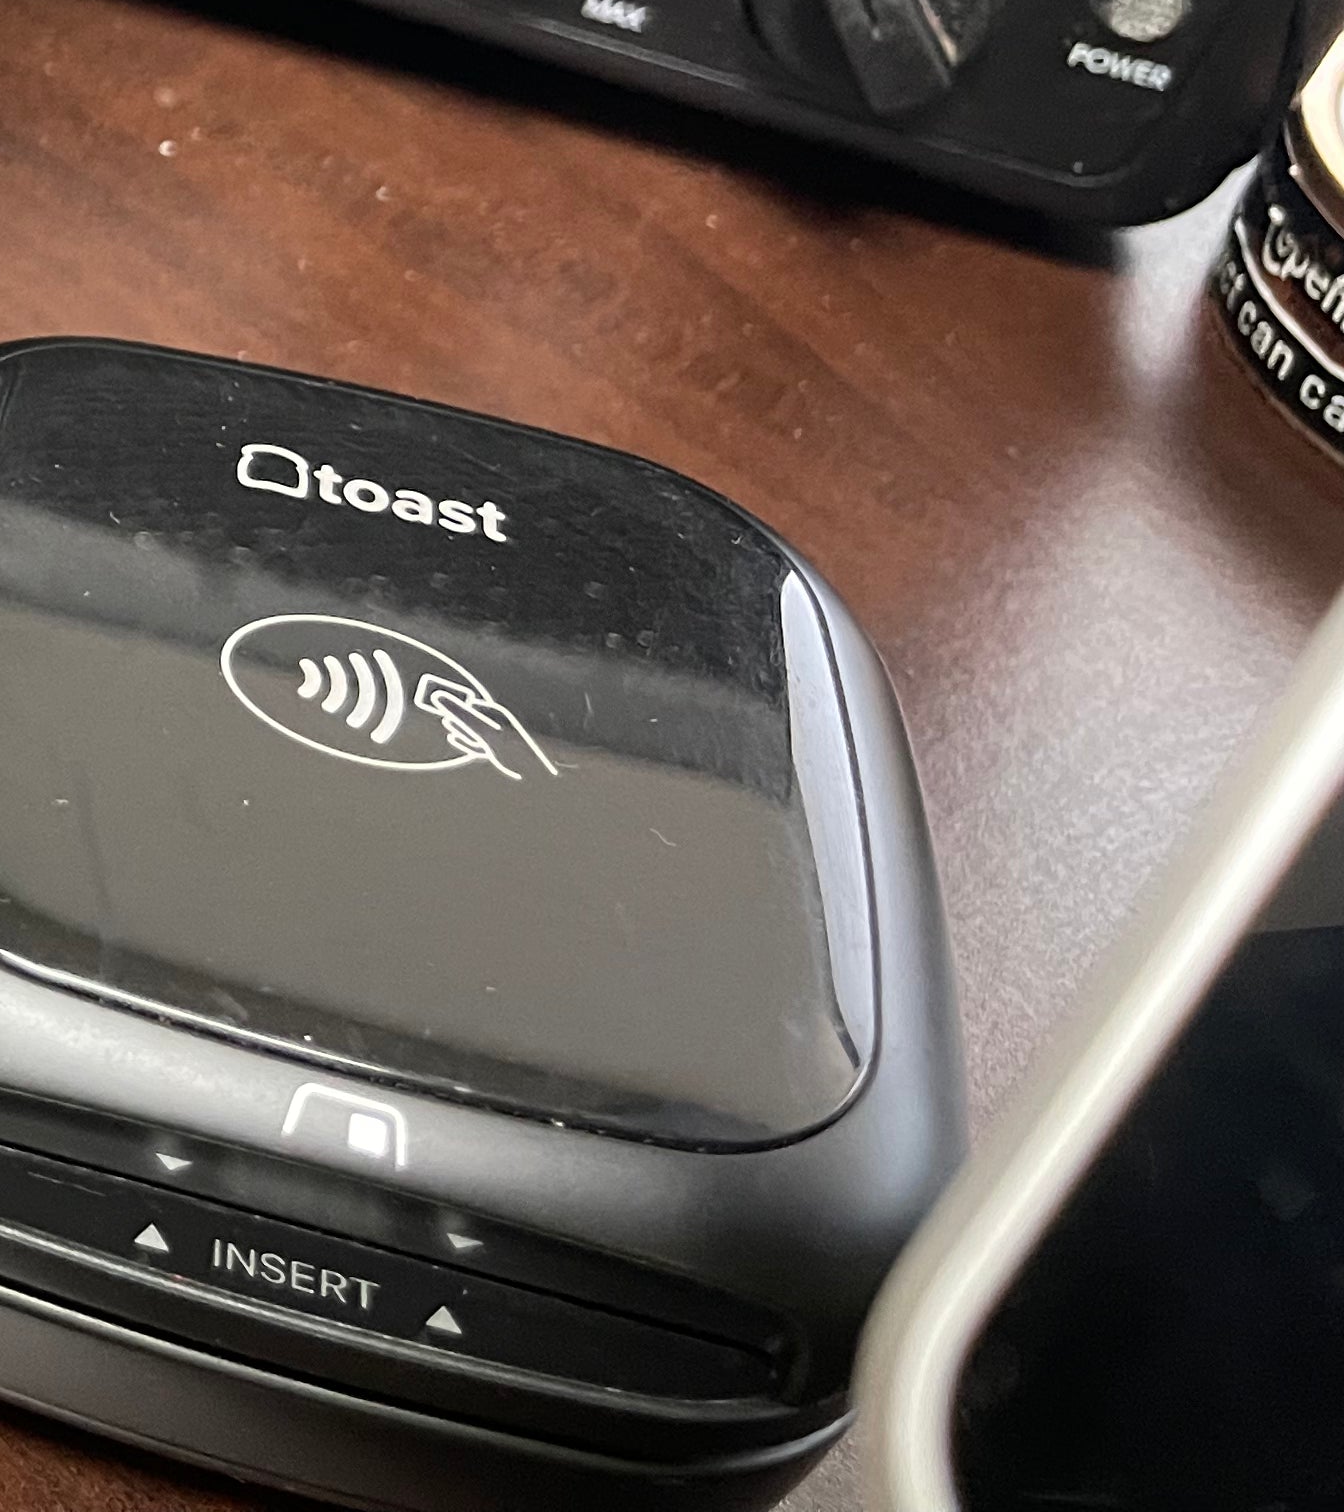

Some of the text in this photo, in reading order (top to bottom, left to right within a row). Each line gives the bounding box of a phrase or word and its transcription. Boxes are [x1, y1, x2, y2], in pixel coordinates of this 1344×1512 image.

[1066, 41, 1173, 92] POWER
[312, 463, 509, 543] toast
[212, 1237, 382, 1311] INSERT
